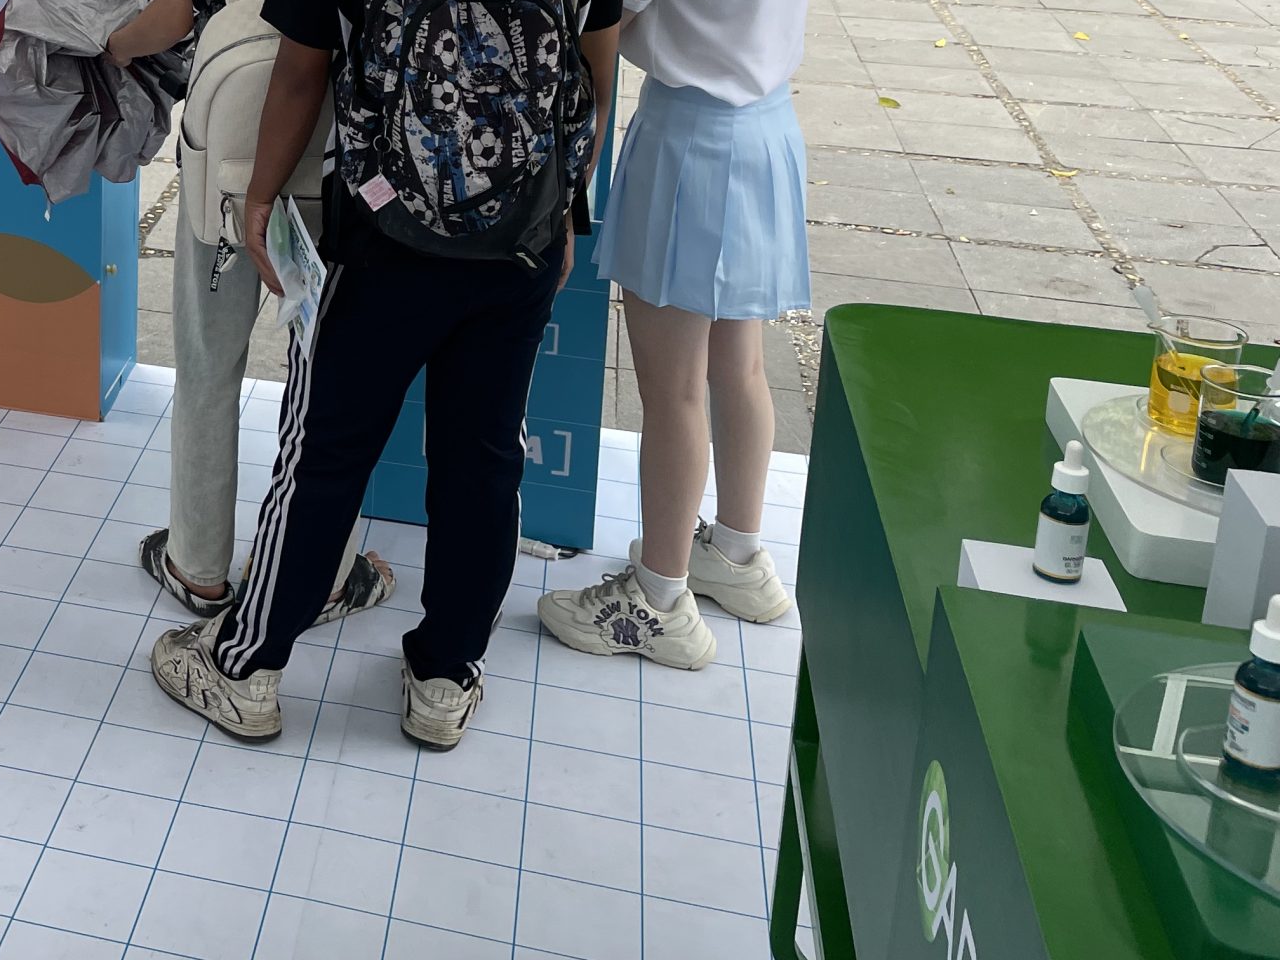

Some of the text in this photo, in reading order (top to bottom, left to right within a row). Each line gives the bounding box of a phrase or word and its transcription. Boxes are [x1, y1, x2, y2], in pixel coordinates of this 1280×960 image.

[211, 272, 220, 290] YOU
[593, 601, 665, 638] NEW YORK
